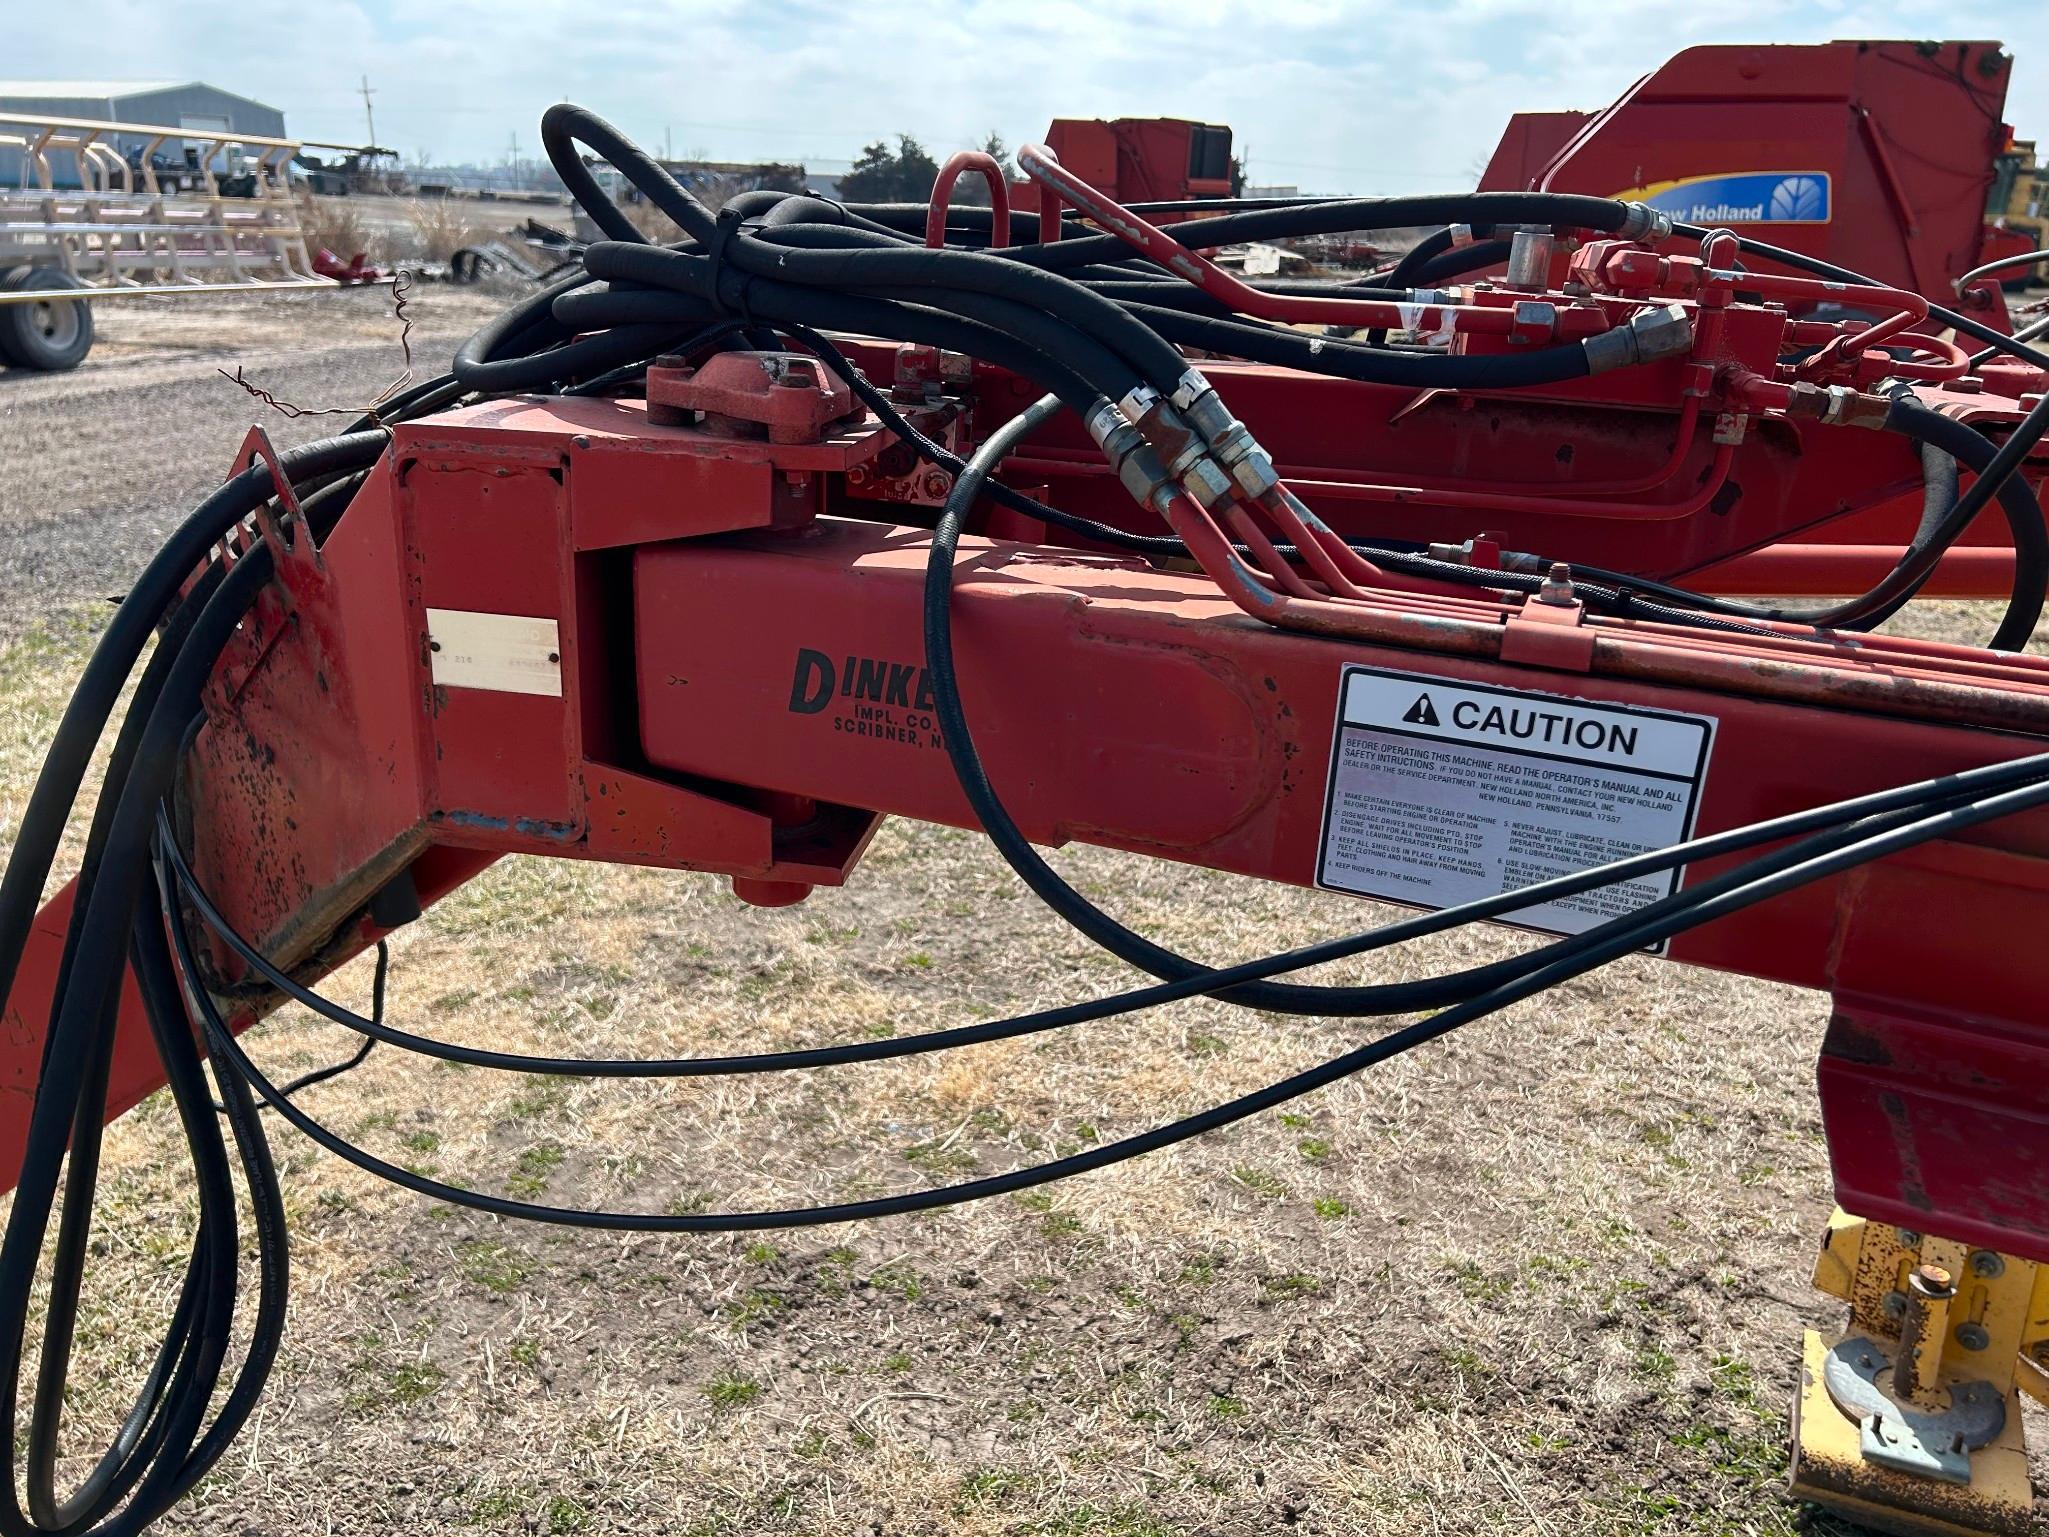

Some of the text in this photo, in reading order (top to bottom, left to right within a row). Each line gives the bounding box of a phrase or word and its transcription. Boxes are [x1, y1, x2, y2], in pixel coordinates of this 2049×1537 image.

[1692, 203, 1763, 221] Holland
[789, 647, 936, 714] DINKE
[854, 704, 938, 733] IMPL. CO.
[1452, 701, 1638, 756] CAUTION
[833, 716, 923, 749] SCRIBNER,
[1342, 759, 1368, 770] DEALER
[1370, 763, 1380, 772] OR
[1382, 766, 1395, 774] THE
[1397, 768, 1426, 780] SERVICE
[1480, 782, 1497, 792] NEW
[1498, 785, 1534, 798] HOLLAND
[1534, 791, 1561, 802] NORTH
[1344, 748, 1375, 760] SAFETY
[1449, 765, 1463, 775] YOU
[1465, 768, 1476, 778] DO
[1477, 770, 1492, 780] NOT
[1493, 773, 1513, 784] HAVE
[1557, 784, 1592, 797] CONTACT
[1594, 790, 1615, 801] YOUR
[1616, 794, 1634, 804] NEW
[1635, 797, 1673, 811] HOLLAND
[1346, 738, 1377, 751] BEFORE
[1380, 743, 1429, 759] OPERATING
[1430, 752, 1450, 763] THIS
[1496, 763, 1521, 775] READ
[1523, 767, 1540, 778] THE
[1541, 770, 1600, 788] OPERATOR'S
[1601, 780, 1642, 795] MANUAL
[1642, 787, 1663, 799] AND
[1664, 790, 1684, 802] ALL
[1344, 792, 1361, 800] MAKE
[1362, 795, 1389, 805] CERTAIN
[1391, 800, 1424, 811] EVERYONE
[1434, 808, 1455, 816] CLEAR
[1466, 814, 1496, 824] MACHINE
[1478, 793, 1495, 802] NEW
[1343, 799, 1368, 809] BEFORE
[1369, 804, 1400, 815] STARTING
[1403, 810, 1426, 819] ENGINE
[1428, 814, 1438, 822] OR
[1339, 825, 1363, 835] BEFORE
[1365, 830, 1393, 840] LEAVING
[1394, 835, 1435, 848] OPERATOR'S
[1341, 811, 1378, 822] DISENGAGE
[1380, 818, 1405, 827] DRIVES
[1407, 823, 1444, 834] INCLUDING
[1464, 833, 1483, 841] STOP
[1367, 823, 1384, 831] WAIT
[1386, 826, 1399, 834] FOR
[1414, 832, 1451, 843] MOVEMENT
[1463, 841, 1482, 849] STOP
[1512, 822, 1534, 831] NEVER
[1607, 839, 1630, 849] CLEAN
[1338, 836, 1355, 844] KEEP
[1357, 839, 1369, 847] ALL
[1371, 842, 1400, 852] SHIELDS
[1438, 855, 1456, 863] KEEP
[1509, 837, 1552, 850] OPERATOR'S
[1553, 845, 1582, 856] MANUAL
[1583, 851, 1597, 859] FOR
[1599, 853, 1613, 861] ALL
[1511, 830, 1541, 840] MACHINE
[1543, 836, 1562, 844] WITH
[1564, 839, 1577, 847] THE
[1579, 842, 1605, 852] ENGINE
[1334, 861, 1350, 869] KEEP
[1351, 865, 1374, 874] RIDERS
[1355, 847, 1386, 857] CLOTHING
[1402, 856, 1417, 864] HAIR
[1418, 859, 1437, 867] AWAY
[1438, 863, 1458, 871] FROM
[1459, 867, 1486, 877] MOVING
[1505, 859, 1520, 867] USE
[1508, 845, 1522, 853] AND
[1524, 848, 1571, 862] LUBRICATION
[1572, 857, 1605, 868] PROCED
[1504, 867, 1533, 877] EMBLEM
[1587, 891, 1629, 904] TRACTORS
[1599, 901, 1620, 910] WHEN
[1605, 886, 1657, 902] USE FLASHING
[1551, 900, 1576, 910] EXCEPT
[1577, 905, 1599, 914] WHEN
